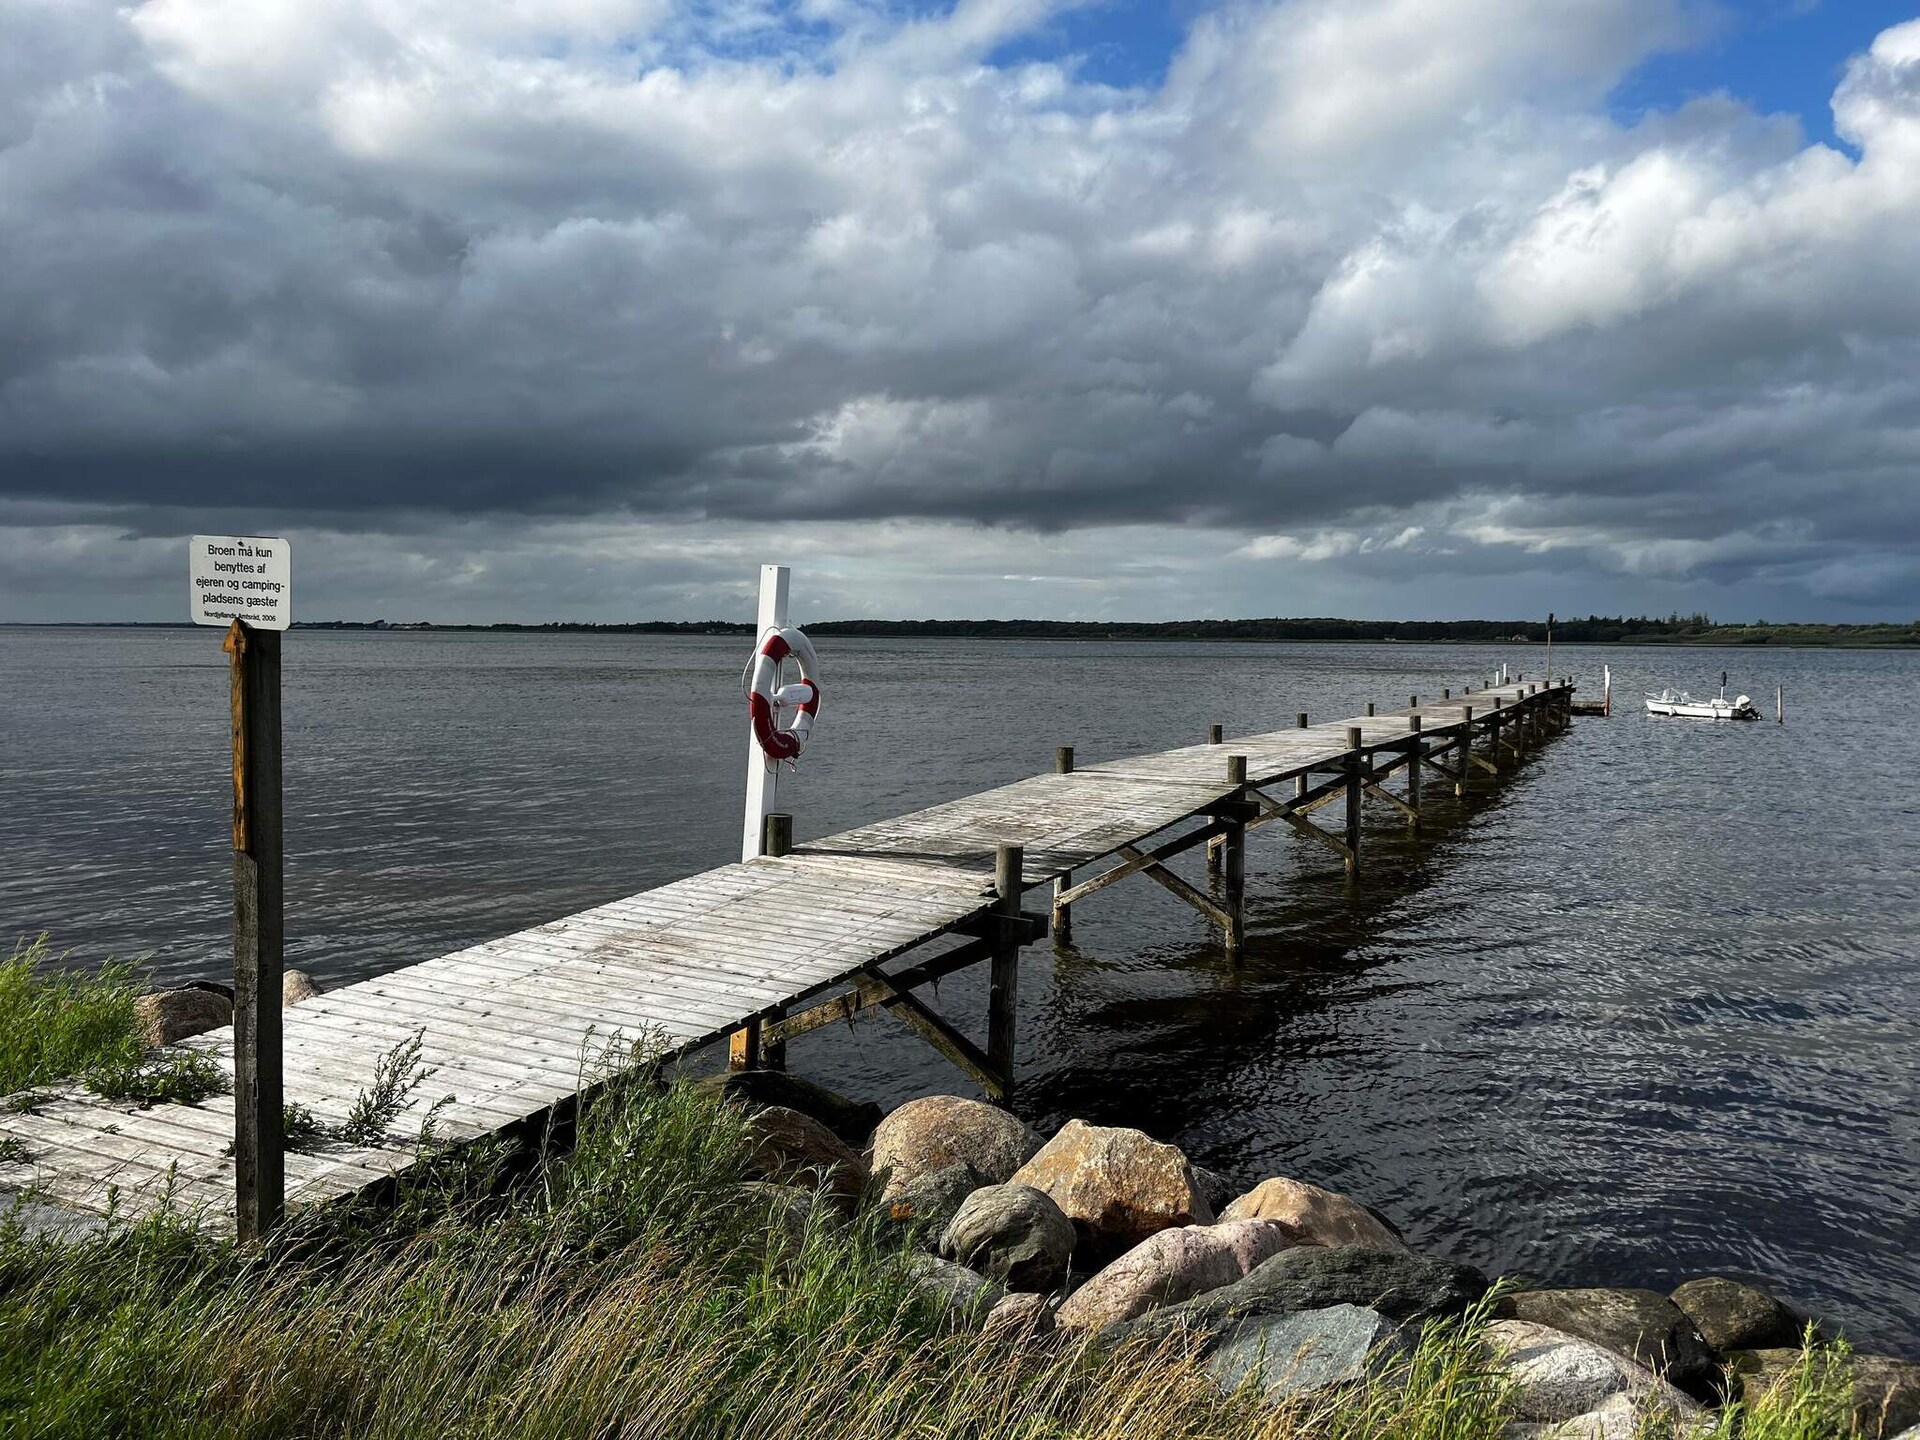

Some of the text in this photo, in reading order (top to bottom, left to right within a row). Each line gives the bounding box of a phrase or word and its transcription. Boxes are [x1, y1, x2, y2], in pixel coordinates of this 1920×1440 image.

[208, 544, 273, 558] Broen må kun
[214, 561, 266, 574] benyttes af
[196, 576, 285, 593] ejeren og camping-
[203, 593, 278, 607] pladsens gæster
